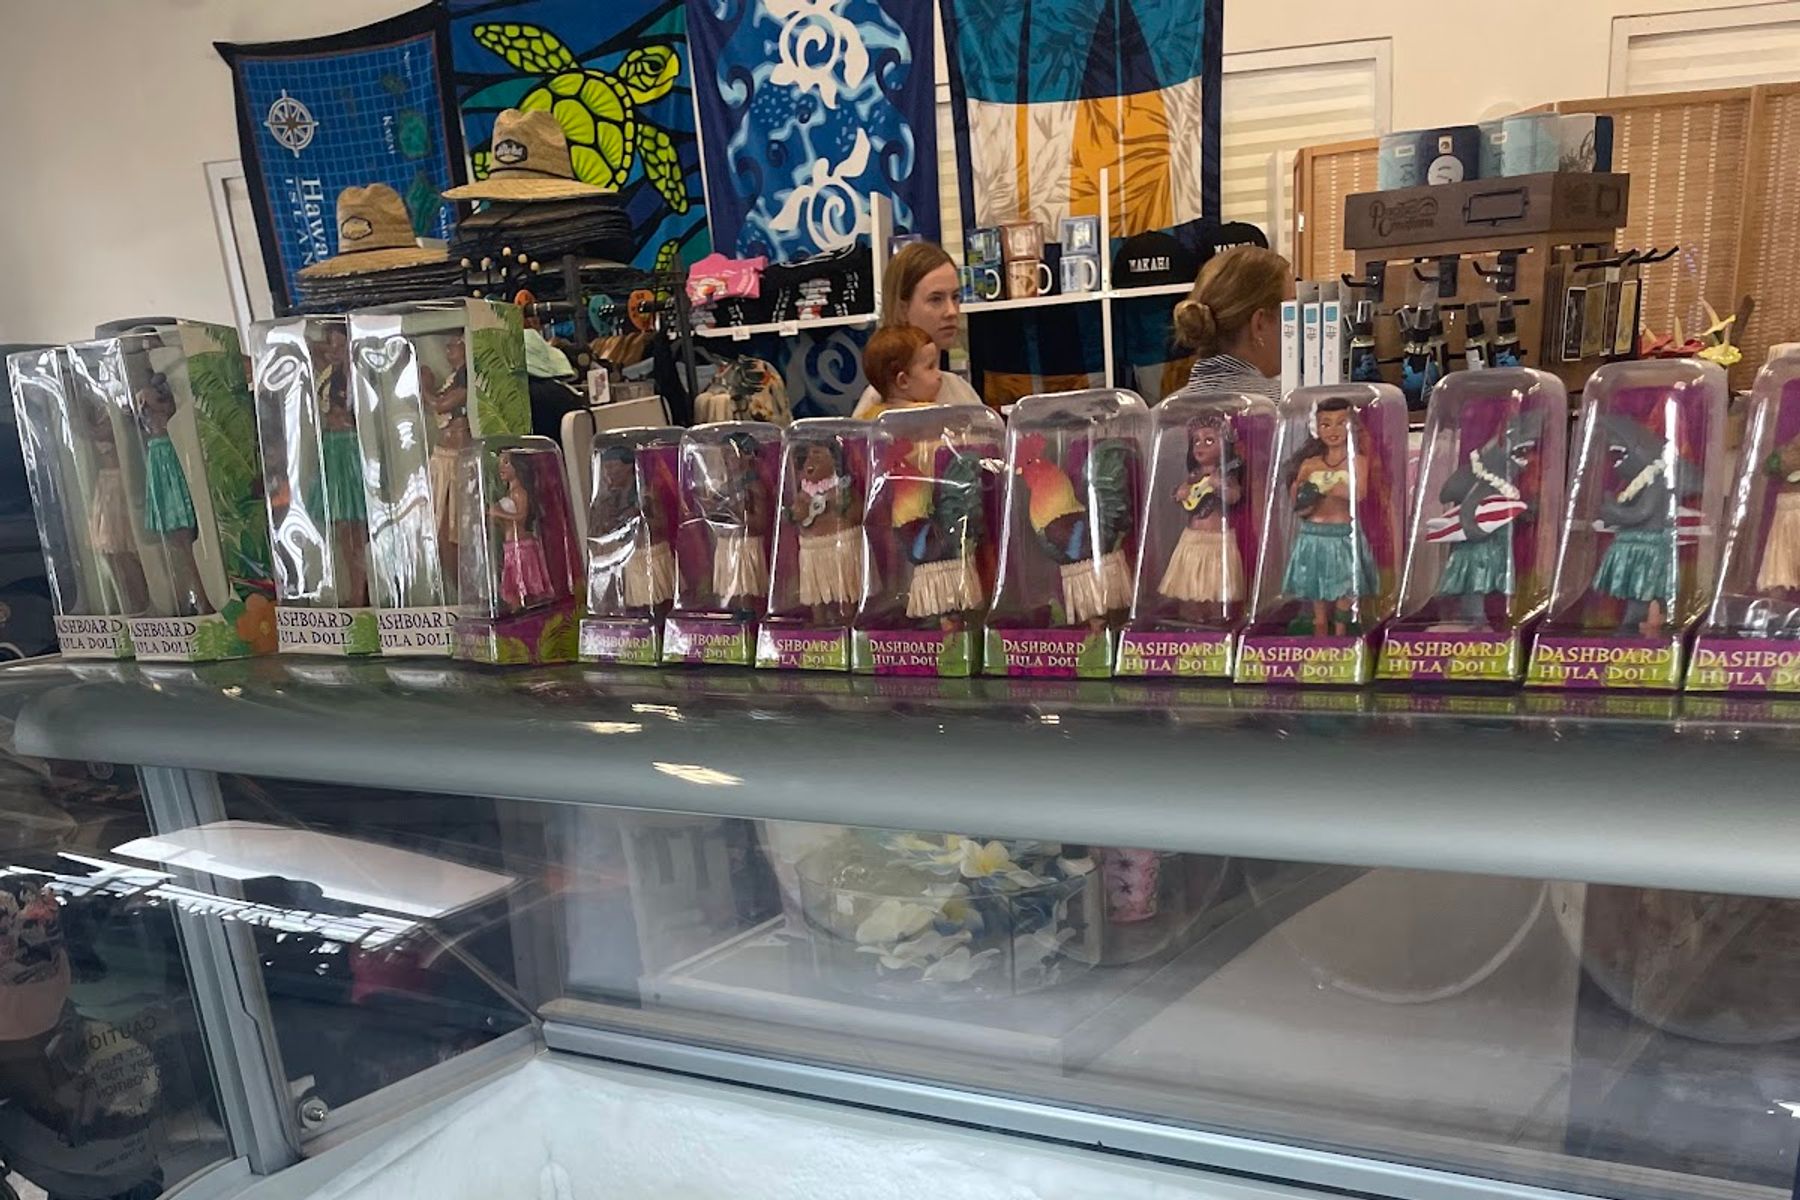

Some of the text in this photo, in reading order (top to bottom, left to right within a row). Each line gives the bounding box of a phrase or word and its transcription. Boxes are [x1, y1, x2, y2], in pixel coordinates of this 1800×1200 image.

[285, 178, 314, 266] ISLAN
[278, 611, 353, 627] ASHBOARD
[379, 611, 459, 629] ASHBOARD
[869, 639, 945, 654] DASHBOARD
[1003, 638, 1086, 654] DASHBOARD
[1123, 640, 1227, 656] DASHBOARD
[1243, 645, 1356, 662] DASHBOARD
[1387, 639, 1508, 657] DASHBOARD
[1537, 644, 1671, 664] DASHBOARD
[872, 653, 943, 667] HULA DOLL
[1005, 655, 1082, 668] HULA DOLL
[1125, 657, 1219, 672] HULA DOLL
[1389, 659, 1502, 673] HULA DOLL
[1245, 663, 1348, 678] HULA DOLL
[1539, 664, 1660, 681] HULA DOLL
[1700, 670, 1766, 686] HULA
